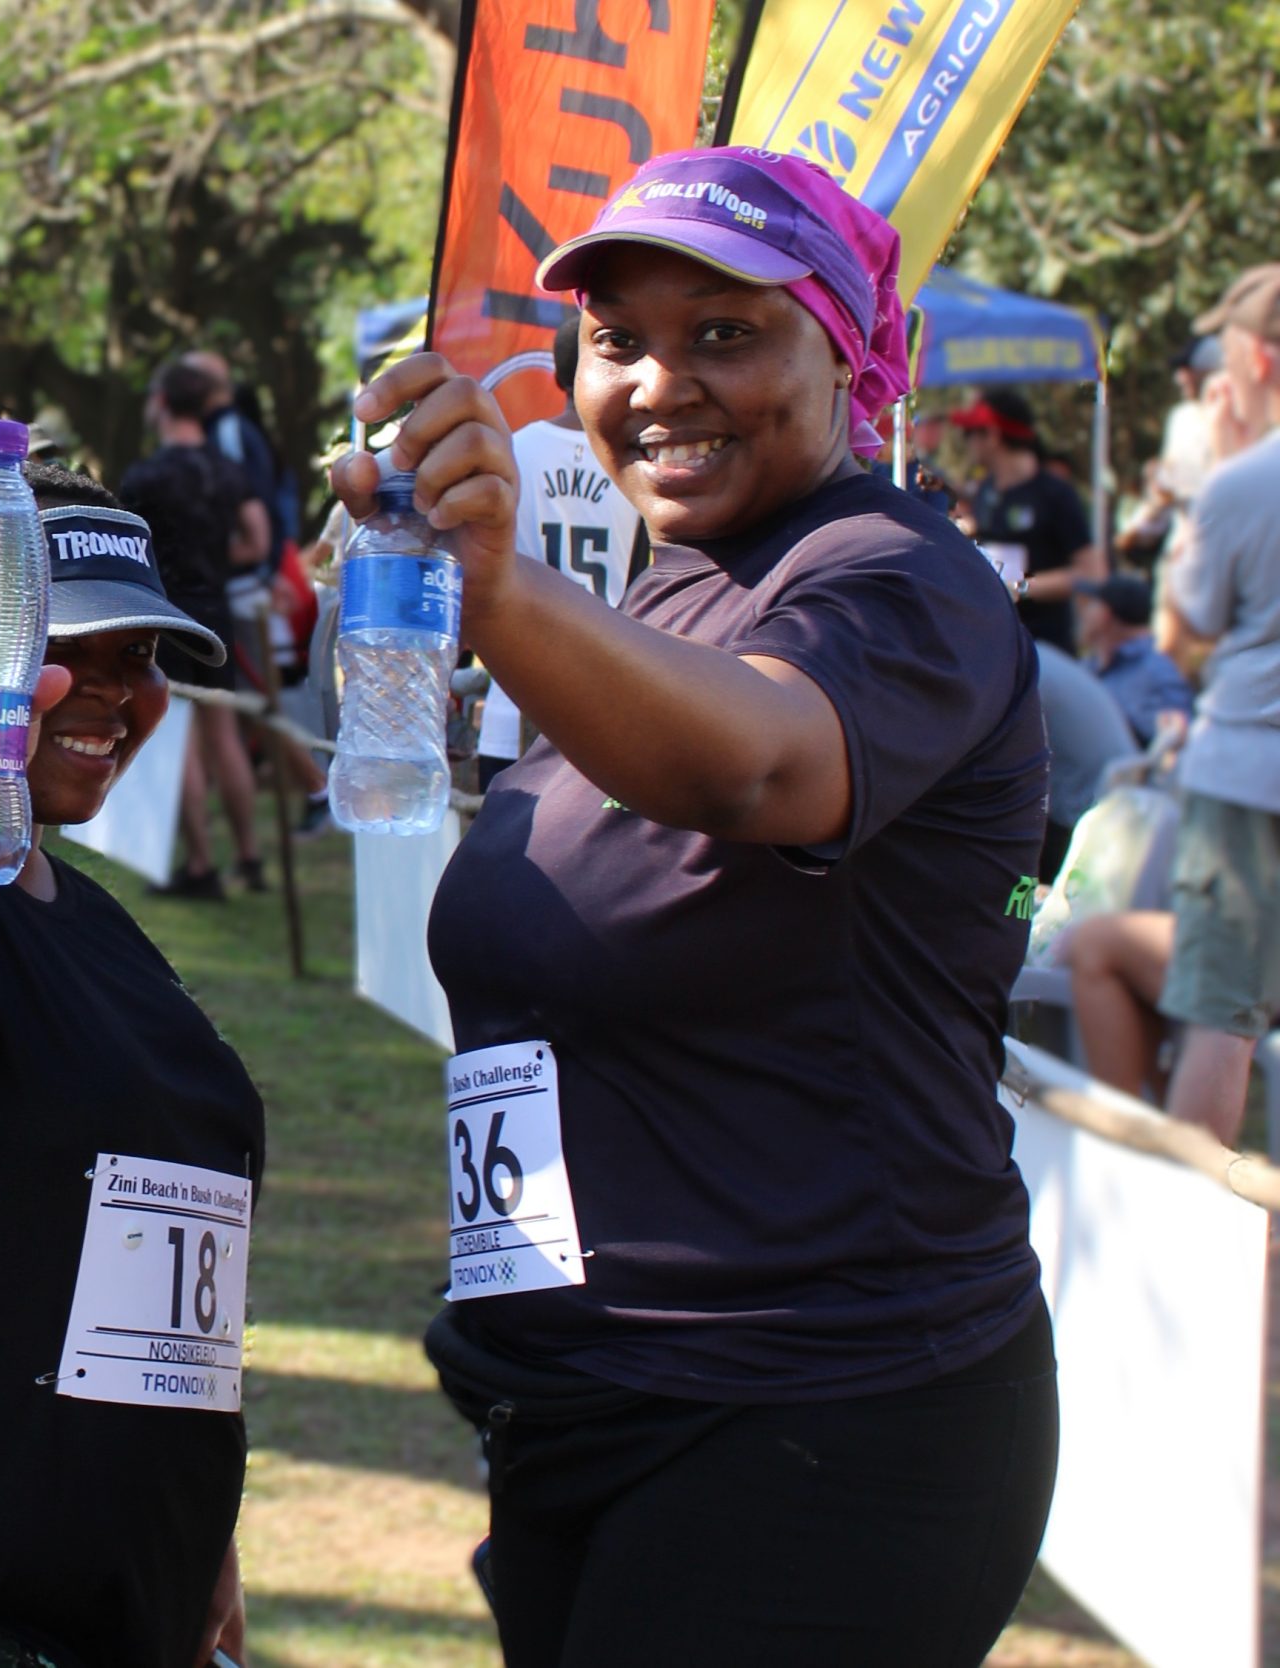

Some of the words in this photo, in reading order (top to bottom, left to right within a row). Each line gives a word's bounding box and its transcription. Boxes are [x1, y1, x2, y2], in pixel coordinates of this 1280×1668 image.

[645, 182, 768, 220] HOLLYWOOD
[734, 212, 766, 230] bets
[543, 468, 611, 503] JOKIC
[52, 531, 150, 567] TRONOX
[542, 522, 610, 607] 15
[473, 1062, 542, 1088] Challenge
[451, 1110, 523, 1223] 36
[108, 1174, 137, 1193] Zini
[141, 1178, 178, 1199] Beach
[190, 1185, 211, 1205] Bush
[168, 1226, 216, 1334] 18
[454, 1263, 497, 1287] TRONOX
[142, 1373, 205, 1395] TRONOX
